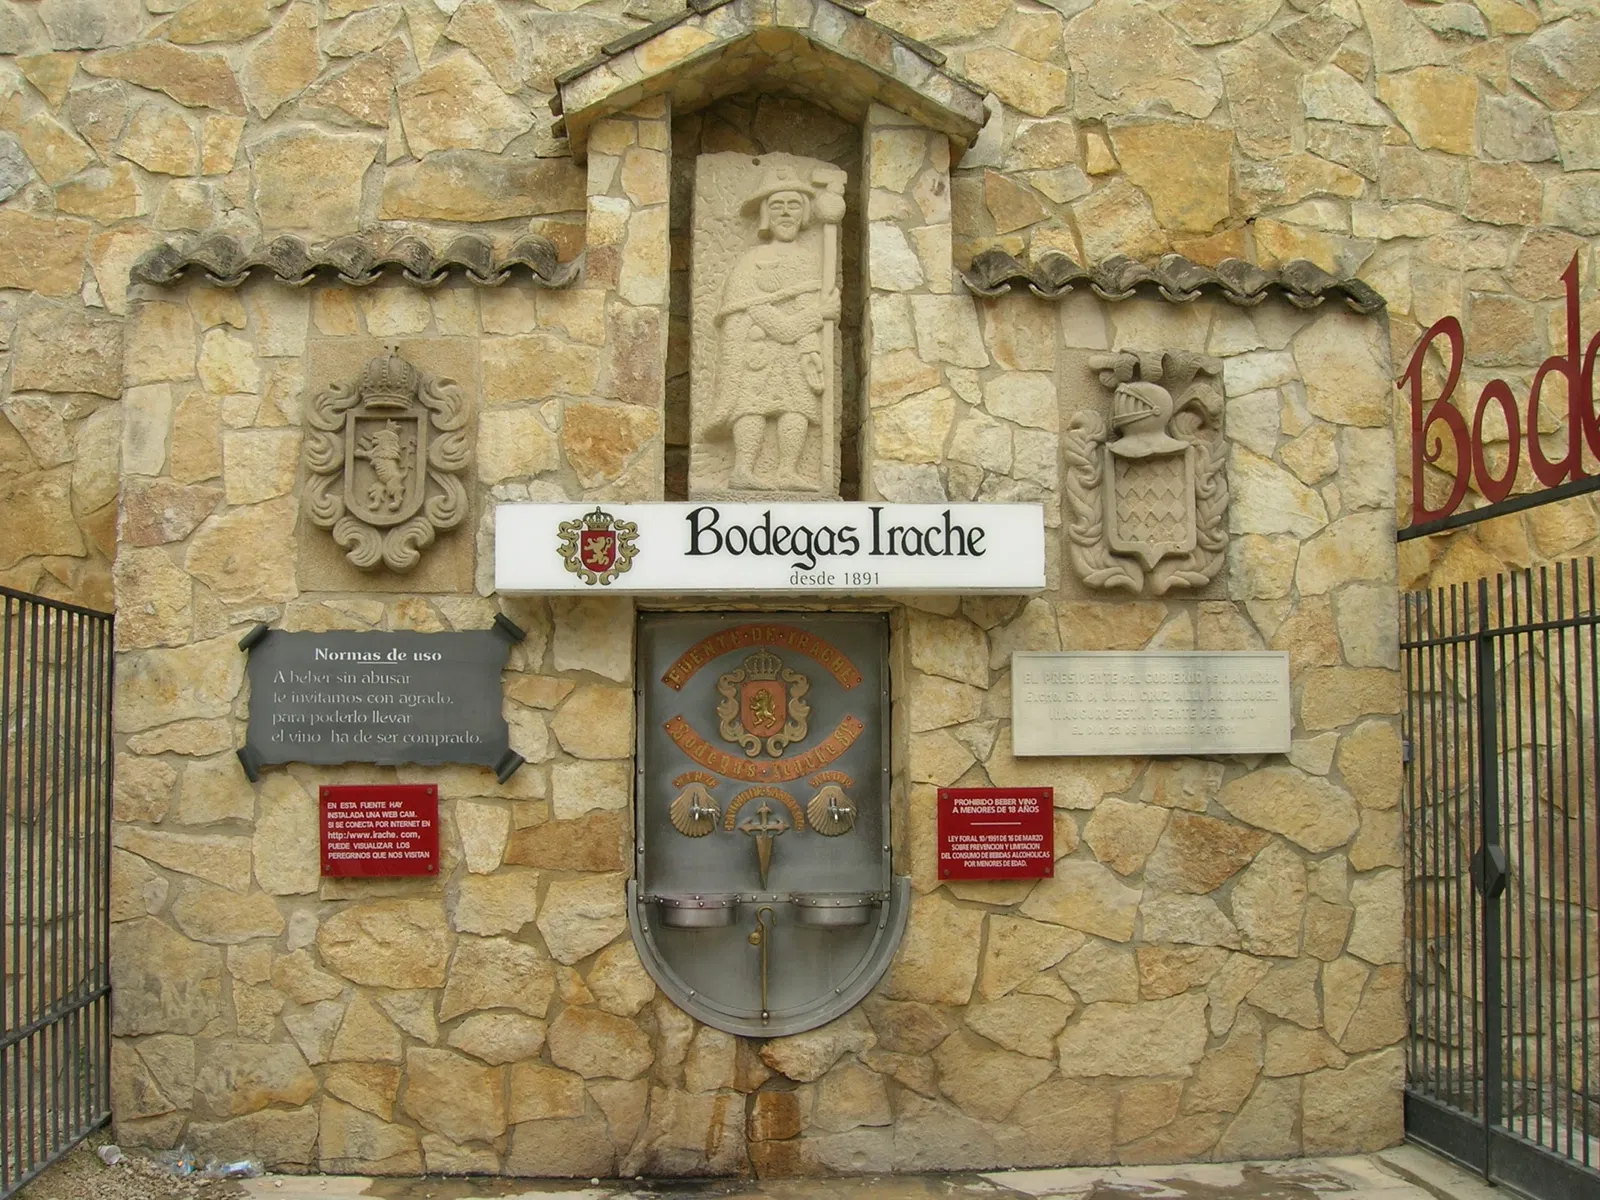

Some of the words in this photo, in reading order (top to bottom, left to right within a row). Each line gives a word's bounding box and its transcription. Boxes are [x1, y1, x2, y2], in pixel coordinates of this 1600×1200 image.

[684, 506, 859, 570] Bodegas
[868, 507, 986, 556] Irache
[790, 571, 835, 585] desde
[844, 572, 879, 585] 1891
[315, 648, 381, 661] Normas
[387, 648, 407, 661] de
[413, 651, 442, 661] uso
[668, 629, 743, 684] FUENTE
[751, 626, 777, 642] DE
[788, 628, 856, 684] IRACHE
[273, 671, 286, 684] A
[290, 671, 331, 684] beber
[336, 672, 357, 684] sin
[361, 671, 412, 684] abusar
[274, 692, 287, 704] te
[291, 692, 362, 704] invitamos
[367, 694, 394, 704] con
[272, 713, 305, 726] para
[311, 710, 367, 726] poderlo
[372, 710, 413, 724] llevar
[271, 730, 284, 743] el
[289, 730, 321, 743] vino
[331, 730, 349, 743] ha
[353, 730, 372, 743] de
[377, 733, 399, 743] ser
[403, 730, 483, 747] comprado.
[360, 801, 386, 809] FUENTE
[952, 806, 959, 814] A
[960, 806, 995, 814] MENORES
[1018, 805, 1039, 813] AÑOS
[327, 811, 364, 819] INSTALADA
[328, 821, 334, 829] SI
[952, 843, 969, 851] SOBRE
